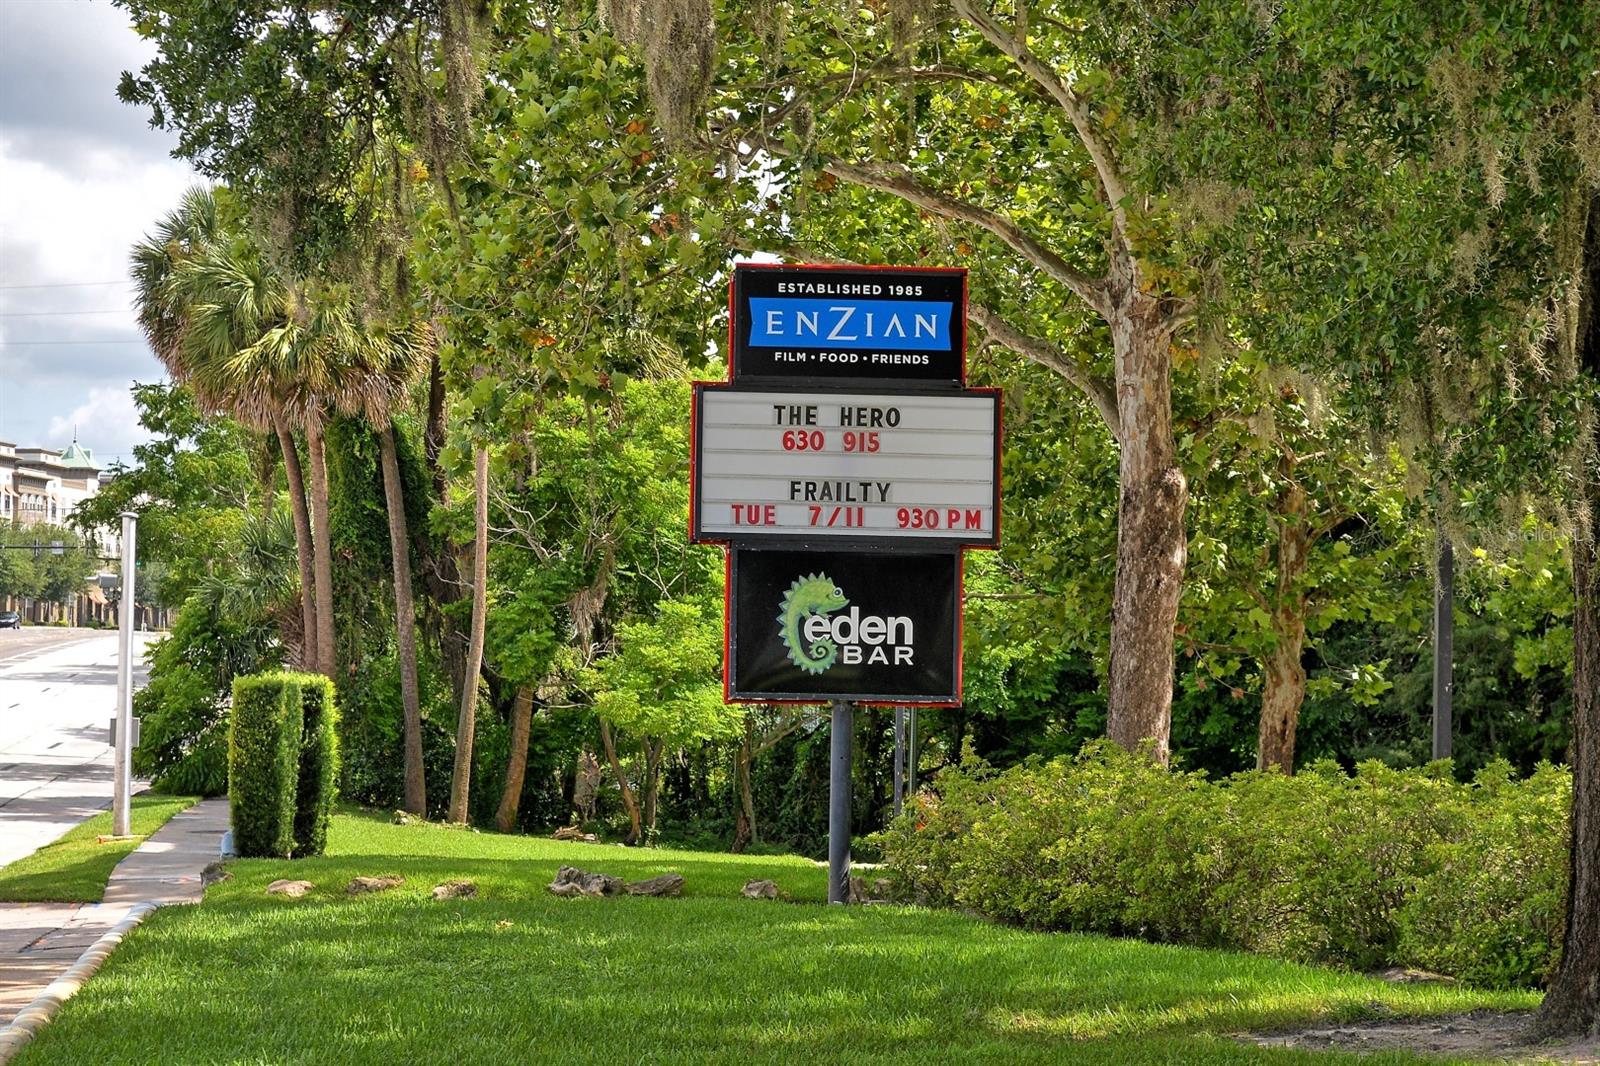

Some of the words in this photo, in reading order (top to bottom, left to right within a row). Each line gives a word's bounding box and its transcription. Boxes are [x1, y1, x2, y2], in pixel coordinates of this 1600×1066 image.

[778, 282, 882, 296] ESTABLISHED
[888, 285, 923, 296] 1985
[766, 306, 938, 341] ENZIAN
[774, 351, 807, 362] FILM
[819, 353, 859, 364] FOOD
[871, 355, 930, 365] FRIENDS
[774, 405, 818, 425] THE
[841, 407, 901, 428] HERO
[782, 430, 825, 450] 630
[843, 432, 880, 452] 915
[790, 481, 891, 502] FRAILTY
[731, 504, 776, 525] TUE
[808, 506, 864, 527] 7/11
[804, 606, 914, 645] eden
[843, 646, 914, 665] BAR
